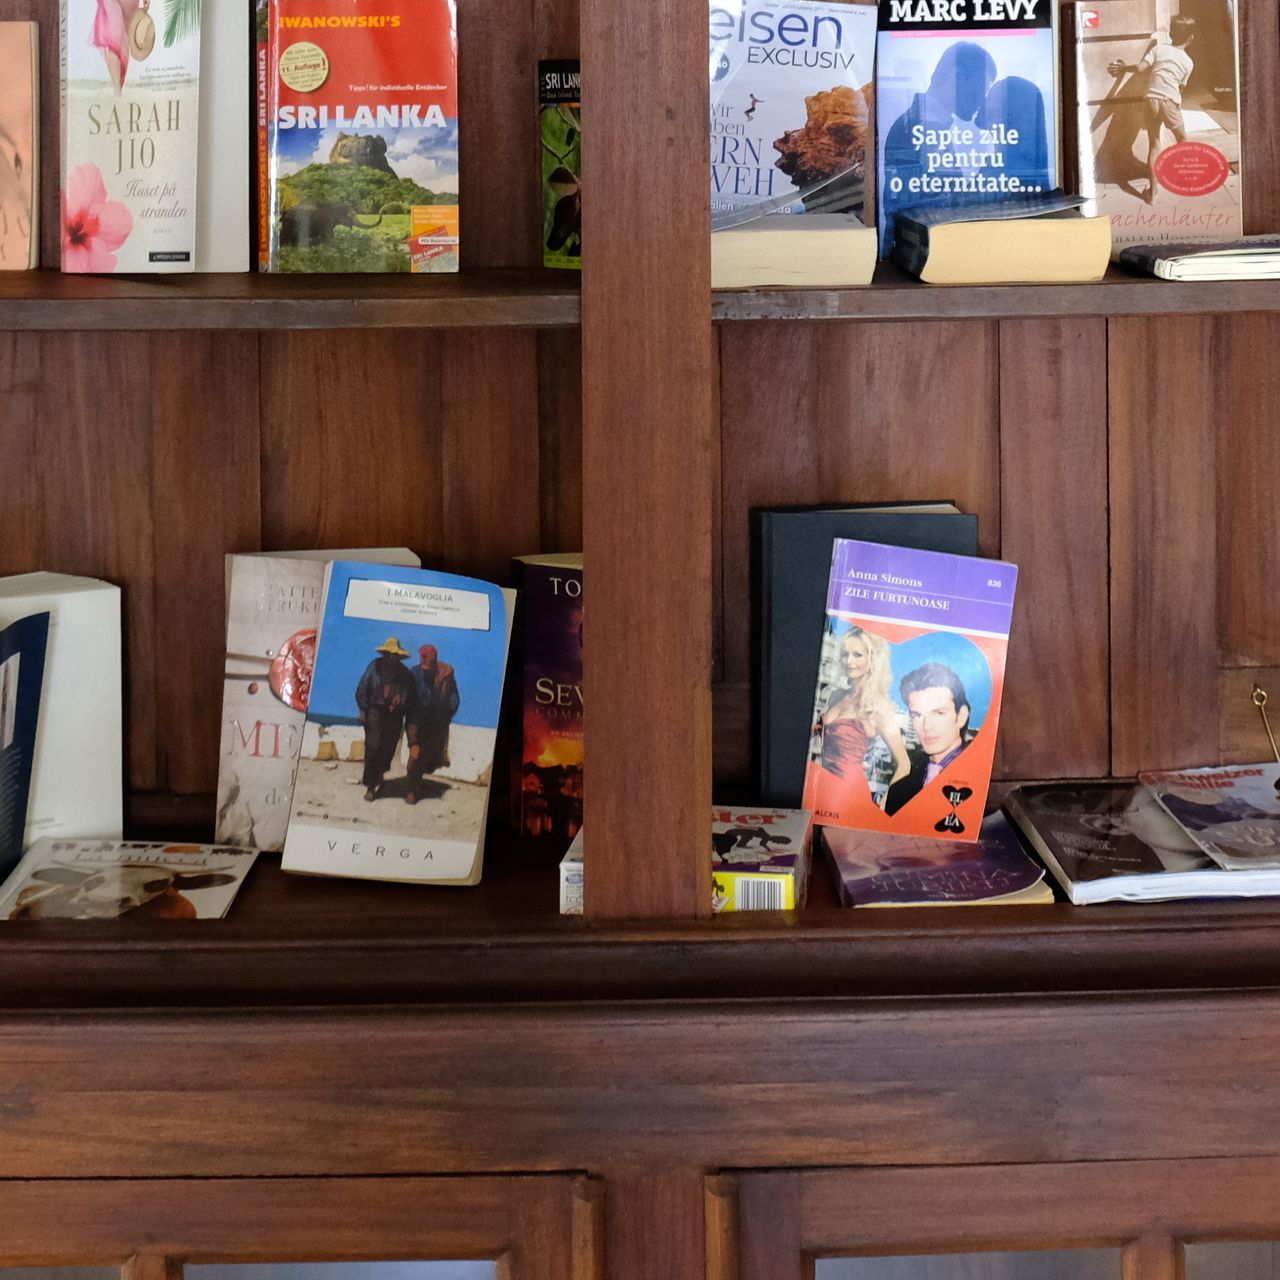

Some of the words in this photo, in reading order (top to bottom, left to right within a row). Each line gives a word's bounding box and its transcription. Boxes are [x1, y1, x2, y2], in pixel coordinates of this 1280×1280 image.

[277, 15, 401, 29] IWANOWSKI'S
[747, 45, 856, 71] EXCLUSIV
[258, 48, 267, 100] LANKA
[545, 72, 561, 90] SRI
[87, 99, 181, 136] SARAH
[258, 104, 267, 128] SRI
[279, 105, 328, 129] SRI
[335, 104, 448, 129] LANKA
[978, 124, 1020, 145] zile
[115, 136, 156, 175] JIO
[927, 150, 1004, 173] pentru
[124, 179, 160, 198] Huset
[158, 180, 177, 204] på
[890, 178, 903, 192] o
[908, 172, 1042, 193] eternitate...
[139, 199, 188, 219] stranden
[846, 567, 879, 582] Anna
[880, 571, 923, 588] Simons
[394, 589, 454, 602] MALAVOGLIA
[844, 586, 871, 600] ZILE
[872, 590, 951, 611] FURTUNOASE
[326, 838, 436, 862] VERGA
